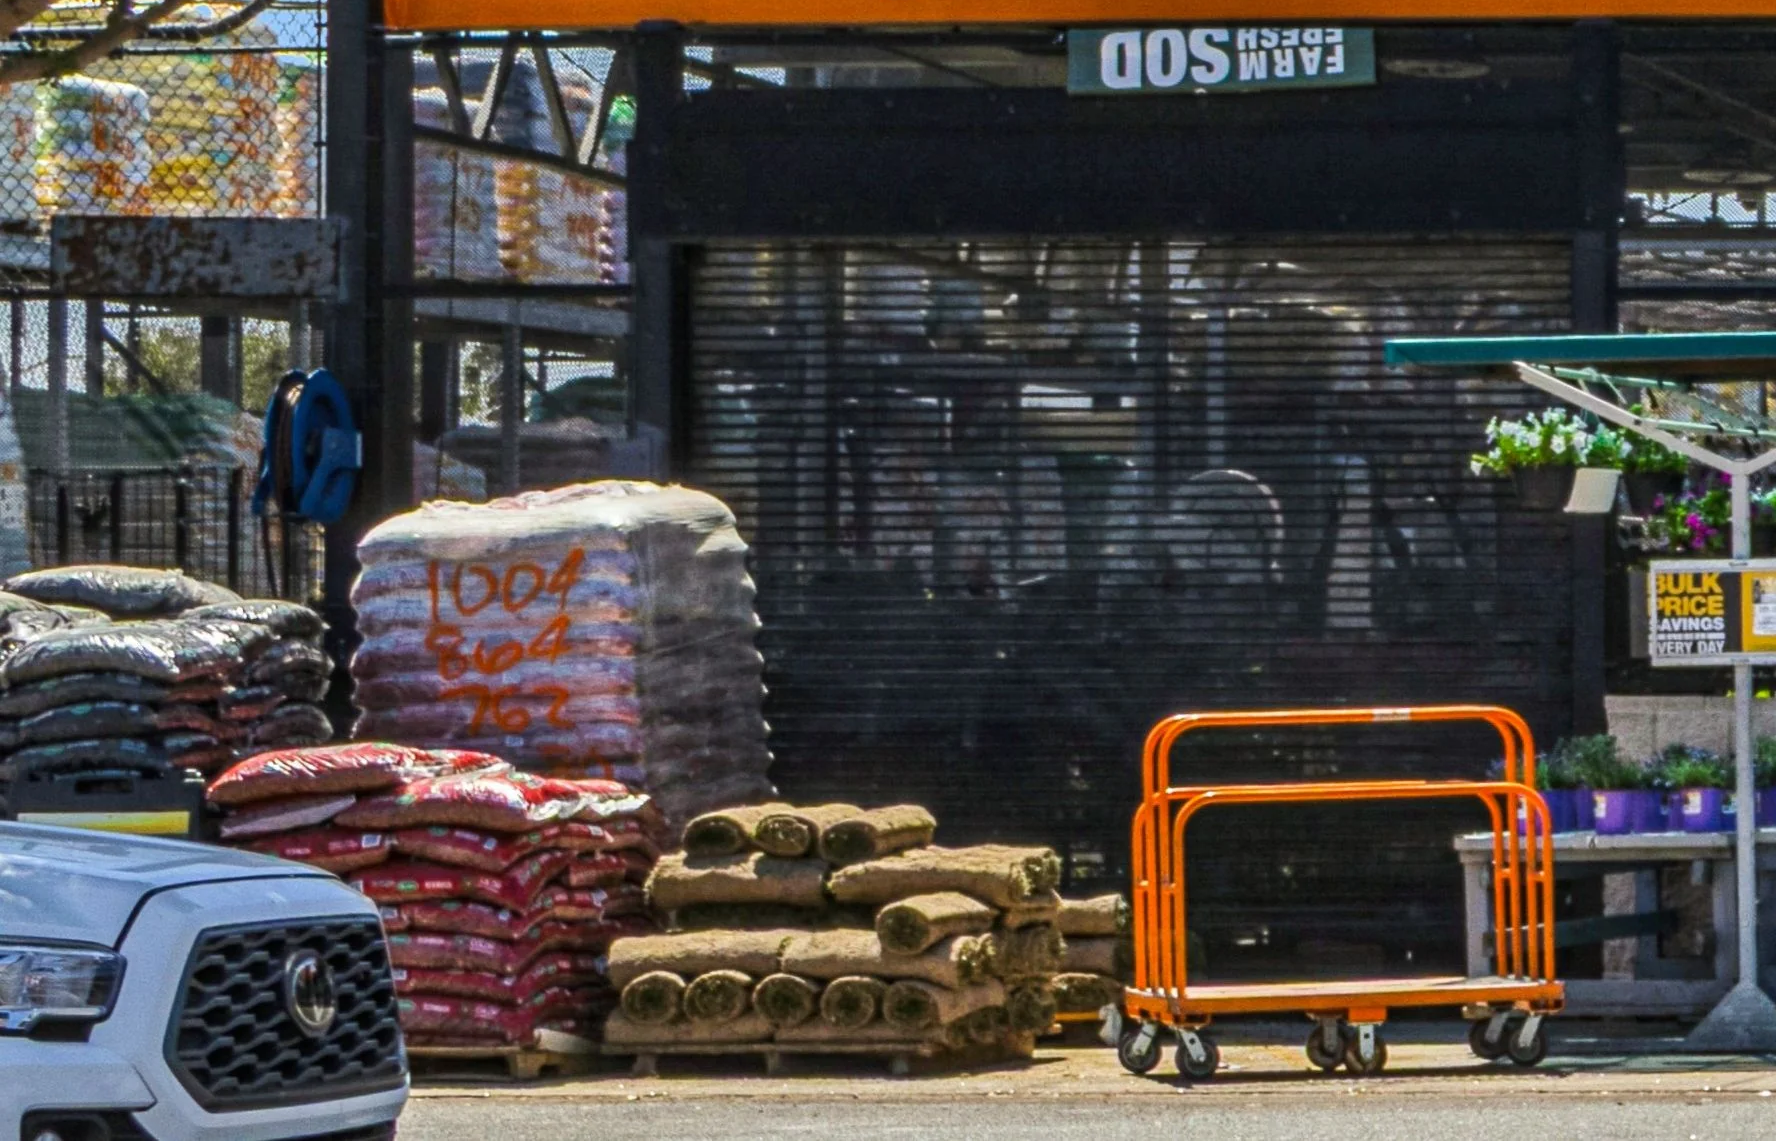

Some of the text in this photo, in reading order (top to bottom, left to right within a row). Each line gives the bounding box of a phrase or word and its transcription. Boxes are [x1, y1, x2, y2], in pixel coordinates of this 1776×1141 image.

[1100, 28, 1230, 89] SOD
[1238, 44, 1345, 81] FARM
[427, 546, 585, 624] 1004
[1650, 572, 1723, 594] BULK
[424, 611, 574, 680] 864
[1697, 641, 1725, 654] DAY
[436, 683, 576, 736] 762
